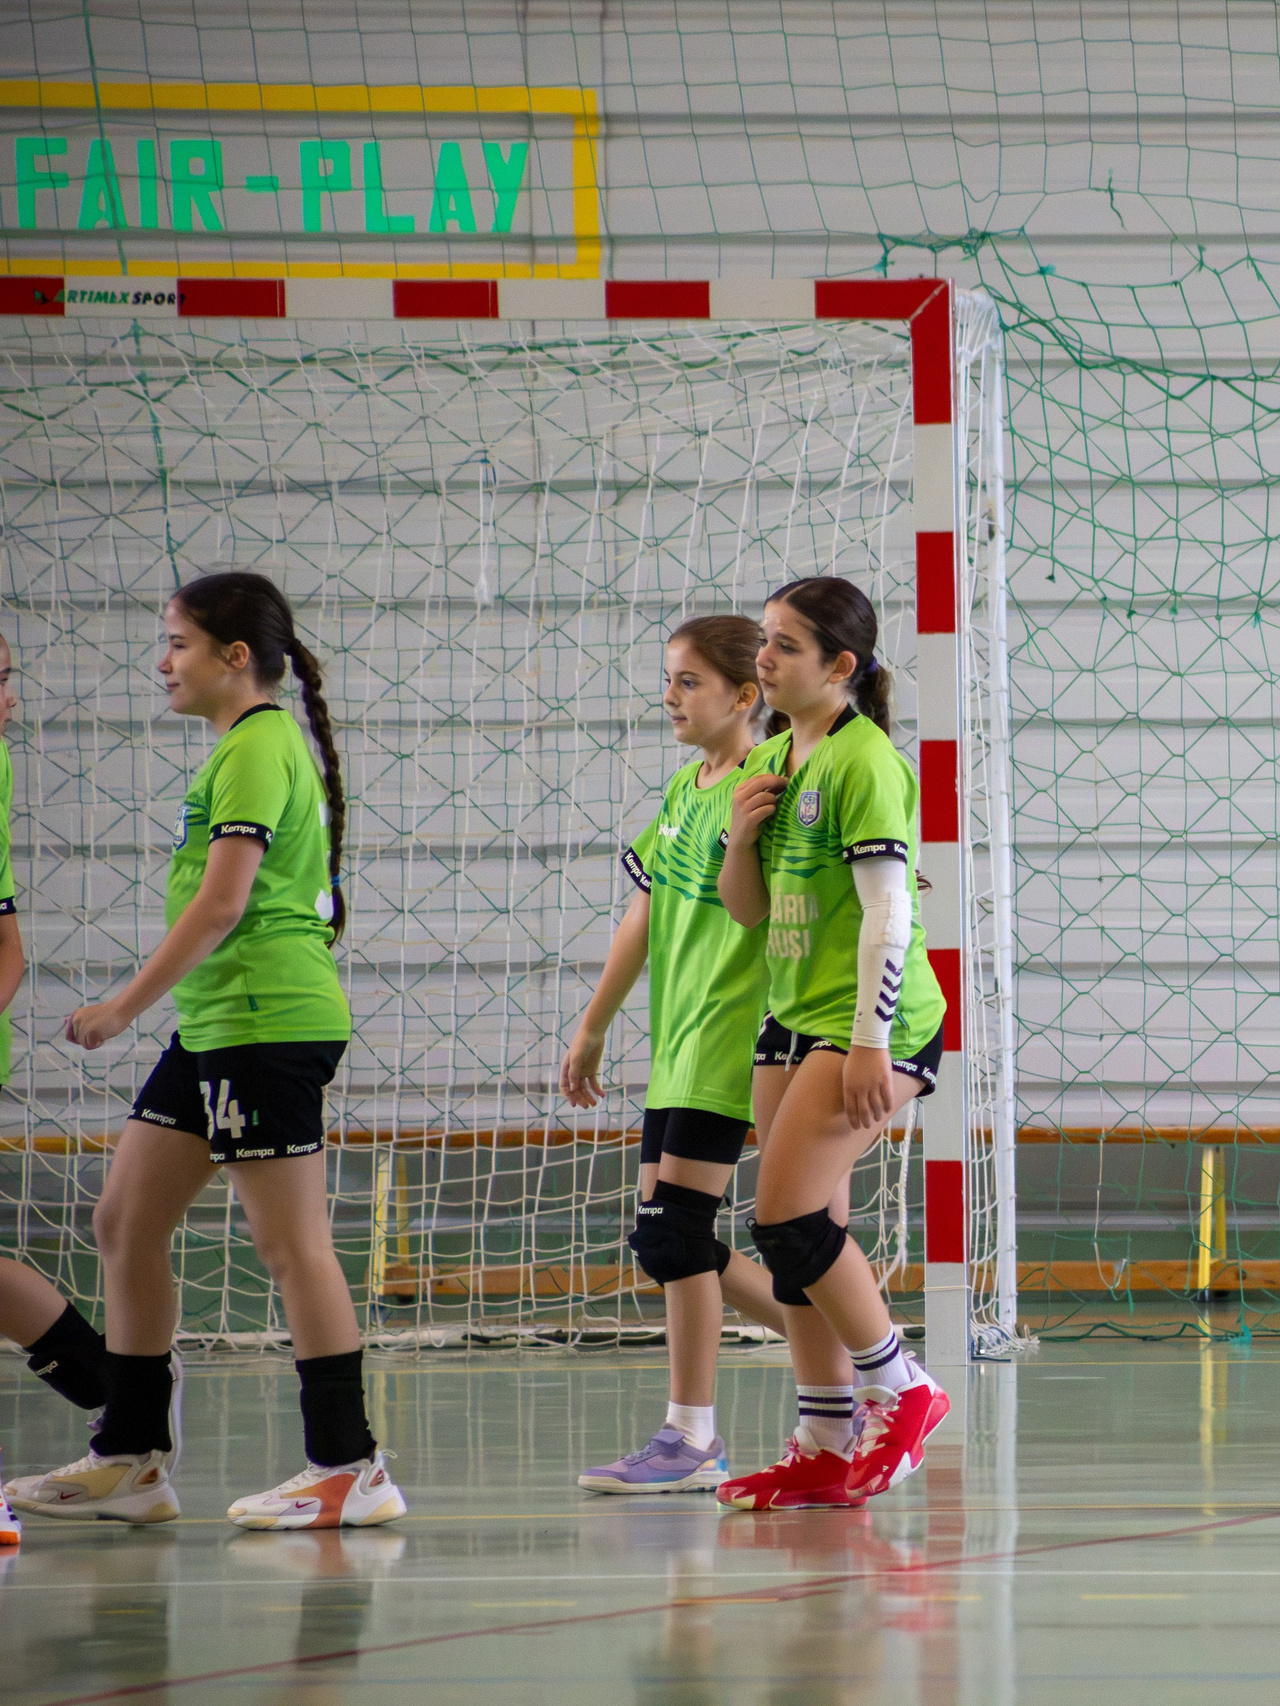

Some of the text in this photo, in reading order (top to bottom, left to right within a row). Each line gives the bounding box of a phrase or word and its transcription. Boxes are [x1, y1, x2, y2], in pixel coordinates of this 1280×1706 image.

[15, 137, 529, 234] FAIR-PLAY
[221, 824, 257, 835] Kempa
[853, 843, 886, 855] Kempa
[625, 852, 642, 878] Kempa
[141, 1108, 177, 1126] Kempa
[236, 1147, 275, 1159] Kempa
[637, 1205, 664, 1217] Kempa
